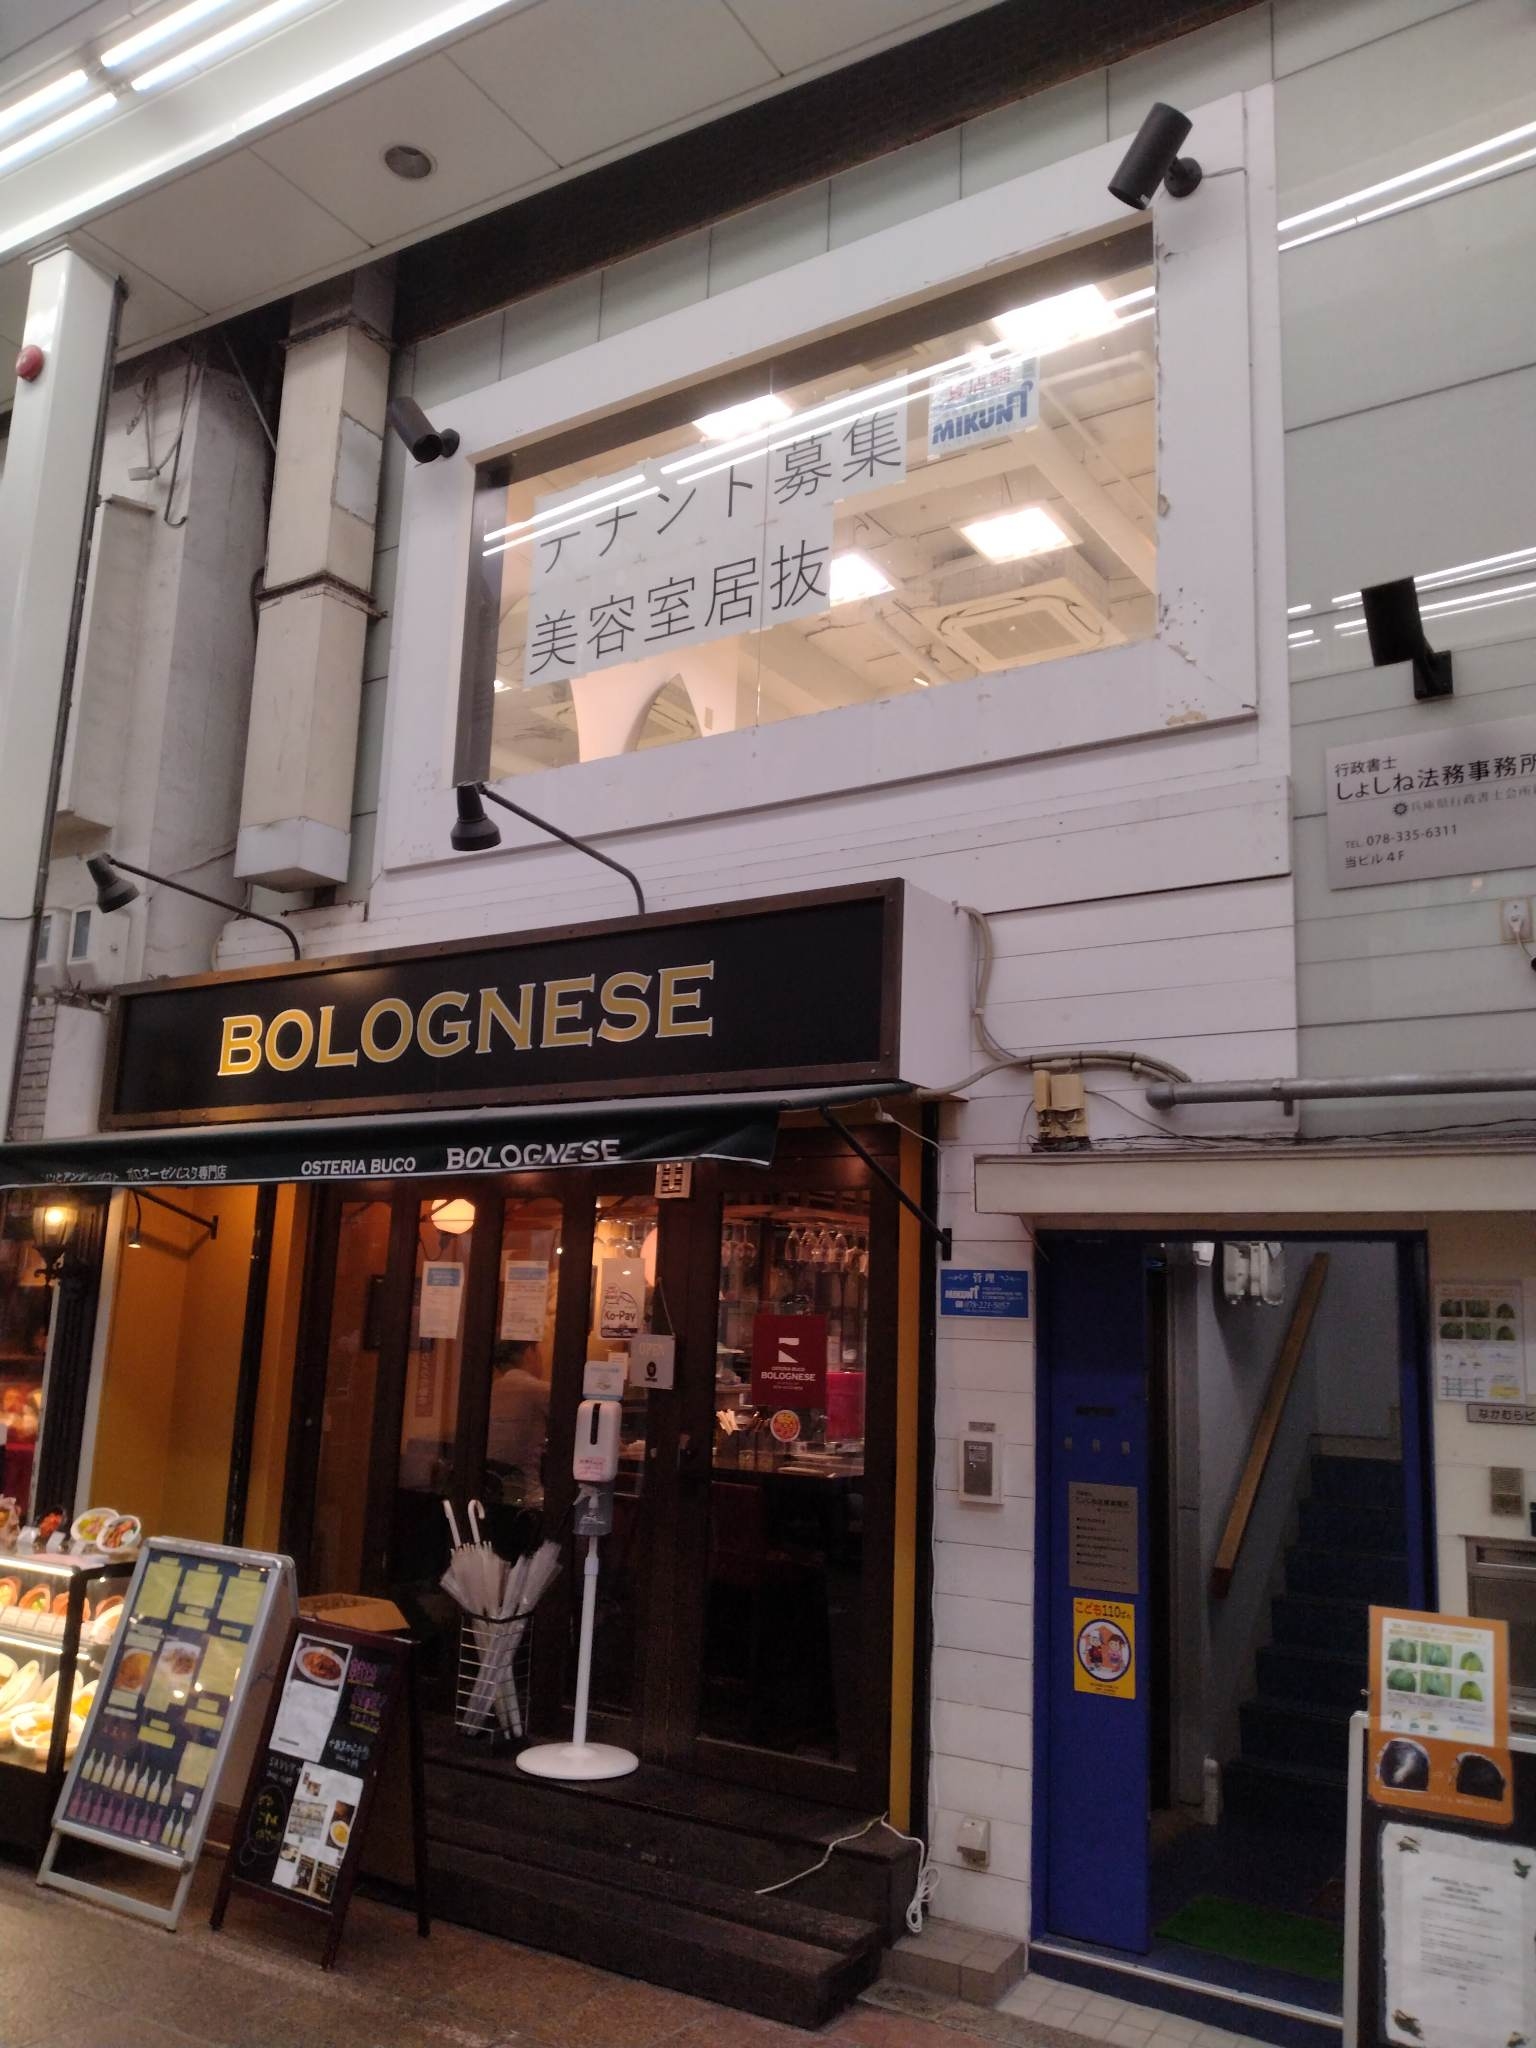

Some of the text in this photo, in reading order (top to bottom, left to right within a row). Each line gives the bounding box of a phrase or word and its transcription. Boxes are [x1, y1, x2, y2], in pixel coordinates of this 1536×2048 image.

[540, 408, 904, 576] テナント募集
[528, 538, 831, 676] 美容室居抜
[1335, 756, 1398, 778] 行政書士
[1366, 823, 1457, 847] 078-335-6311
[217, 960, 716, 1078] BOLOGNESE
[300, 1156, 416, 1177] OSTERIA BUCO
[445, 1139, 620, 1171] BOLOGNESE
[761, 1371, 817, 1381] BOLOGNESE
